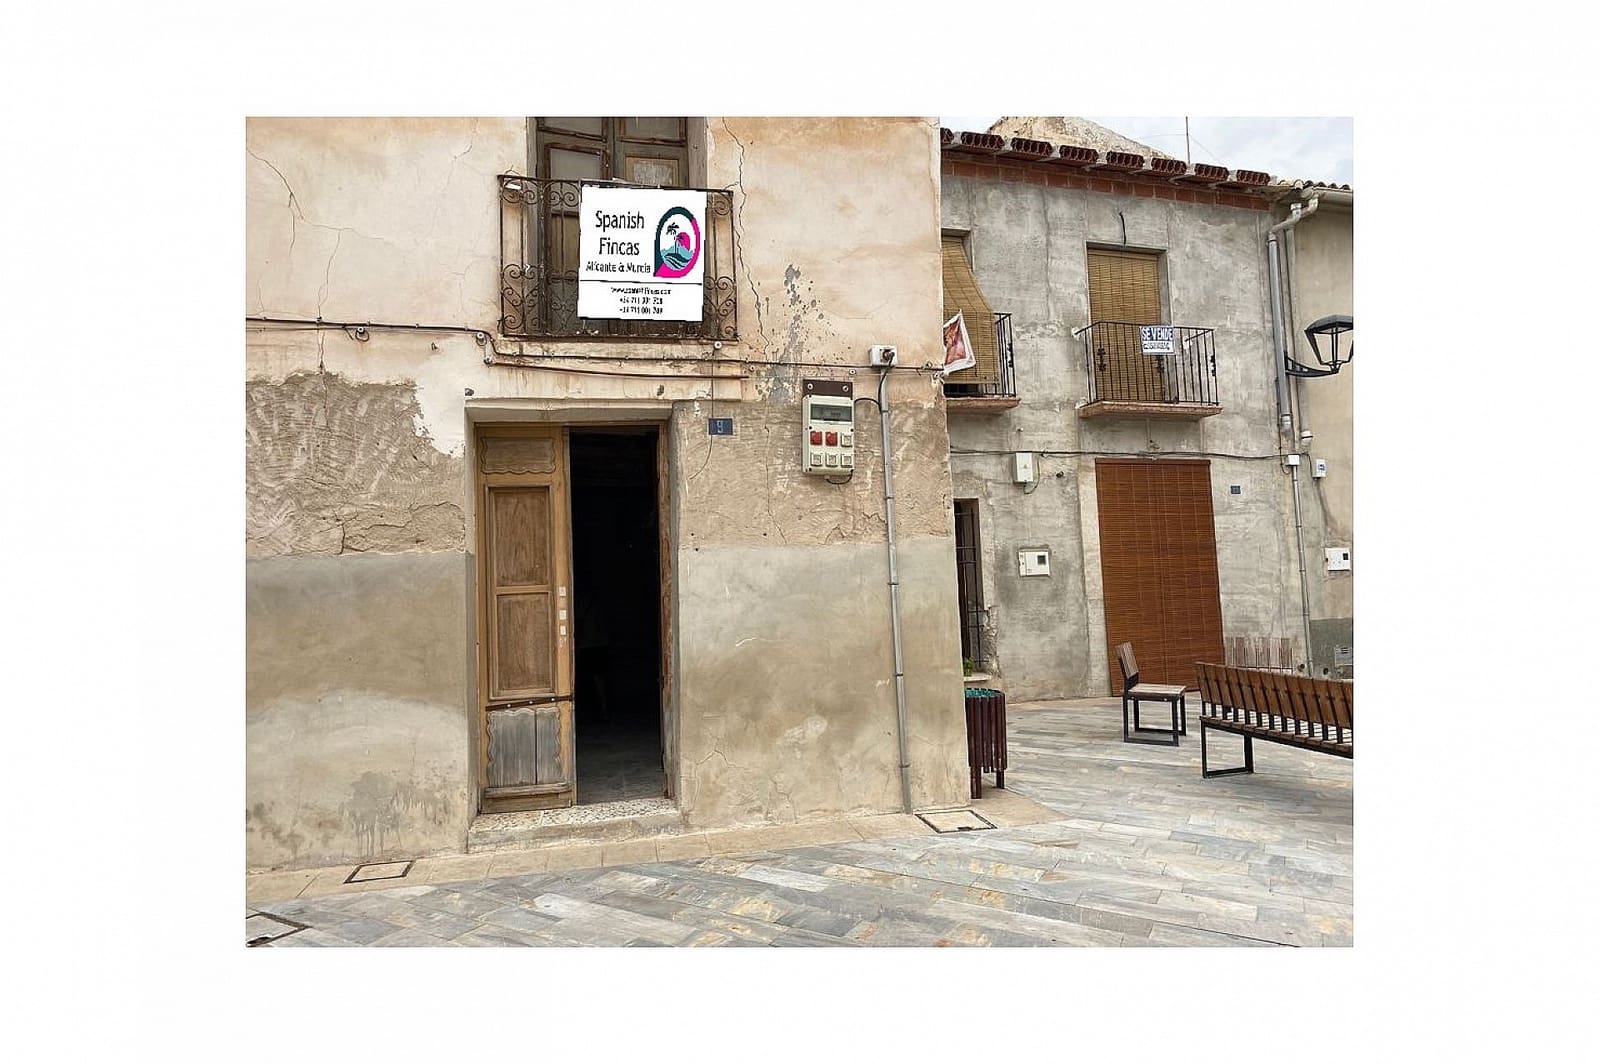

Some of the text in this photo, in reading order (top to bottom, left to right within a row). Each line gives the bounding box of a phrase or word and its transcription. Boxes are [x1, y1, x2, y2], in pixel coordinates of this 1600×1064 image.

[595, 210, 645, 233] Spanish
[598, 237, 640, 256] Fincas
[1142, 327, 1173, 340] SE VENDE
